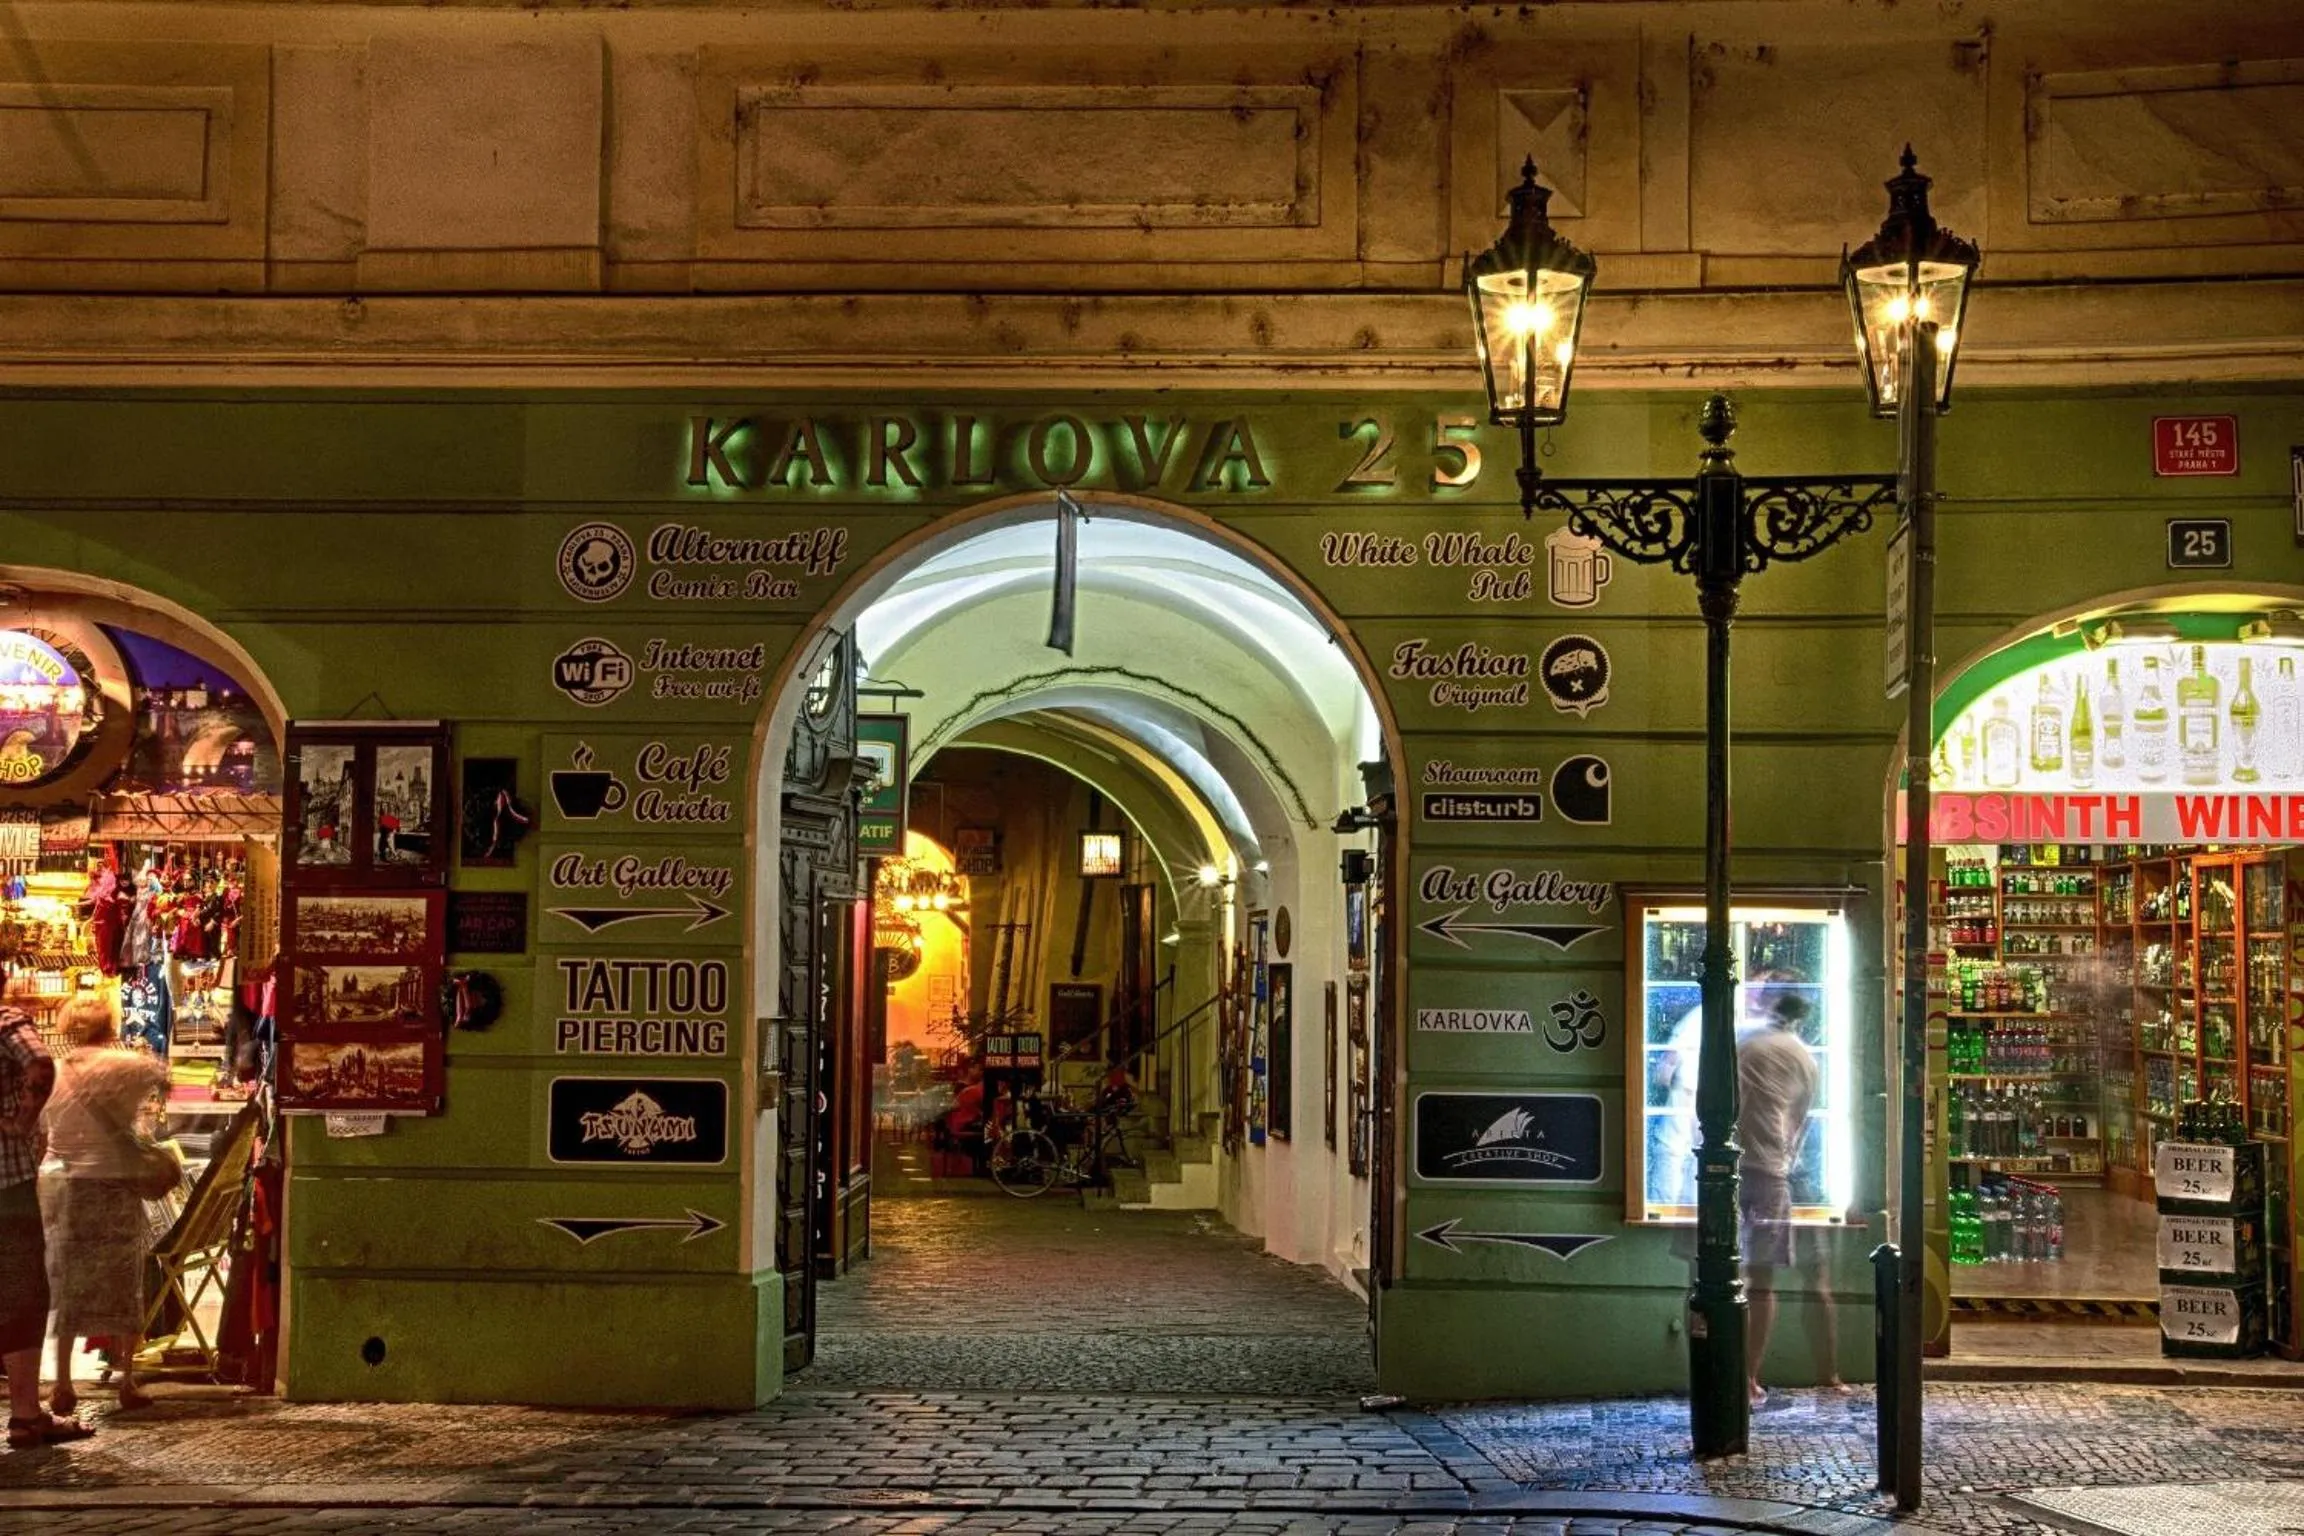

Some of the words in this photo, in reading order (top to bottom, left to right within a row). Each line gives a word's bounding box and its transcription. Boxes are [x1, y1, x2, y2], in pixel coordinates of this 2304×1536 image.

[2173, 422, 2217, 446] 145
[685, 414, 1271, 487] KARLOVA
[1337, 414, 1482, 488] 25
[649, 523, 847, 576] Alternatiff
[1320, 532, 1418, 567] White
[1423, 531, 1535, 567] Whale
[2183, 531, 2216, 556] 25
[649, 570, 737, 600] Comix
[743, 569, 799, 599] Bar
[1469, 569, 1532, 602] Pub
[639, 639, 764, 671] Internet
[1388, 639, 1530, 679] Fashion
[652, 674, 703, 699] Free
[706, 674, 761, 704] wi-fi
[636, 742, 731, 793] Café
[1423, 760, 1540, 786] Showroom
[634, 789, 731, 823] Arieta
[1429, 798, 1535, 817] disturb
[551, 852, 606, 889] Art
[611, 855, 733, 899] Gallery
[1420, 865, 1480, 903] Art
[1484, 869, 1612, 914] Gallery
[557, 958, 728, 1015] TATTOO
[556, 1018, 727, 1055] PIERCING
[1419, 1011, 1532, 1031] KARLOVKA
[580, 1111, 697, 1143] TSUNAMI
[1461, 1149, 1520, 1162] CREATIVE
[1527, 1150, 1559, 1163] SHOP
[2174, 1158, 2223, 1173] BEER
[2182, 1179, 2200, 1194] 25
[2172, 1229, 2223, 1245] BEER
[2182, 1251, 2200, 1265] 25
[2176, 1299, 2227, 1316] BEER
[2187, 1321, 2205, 1336] 25
